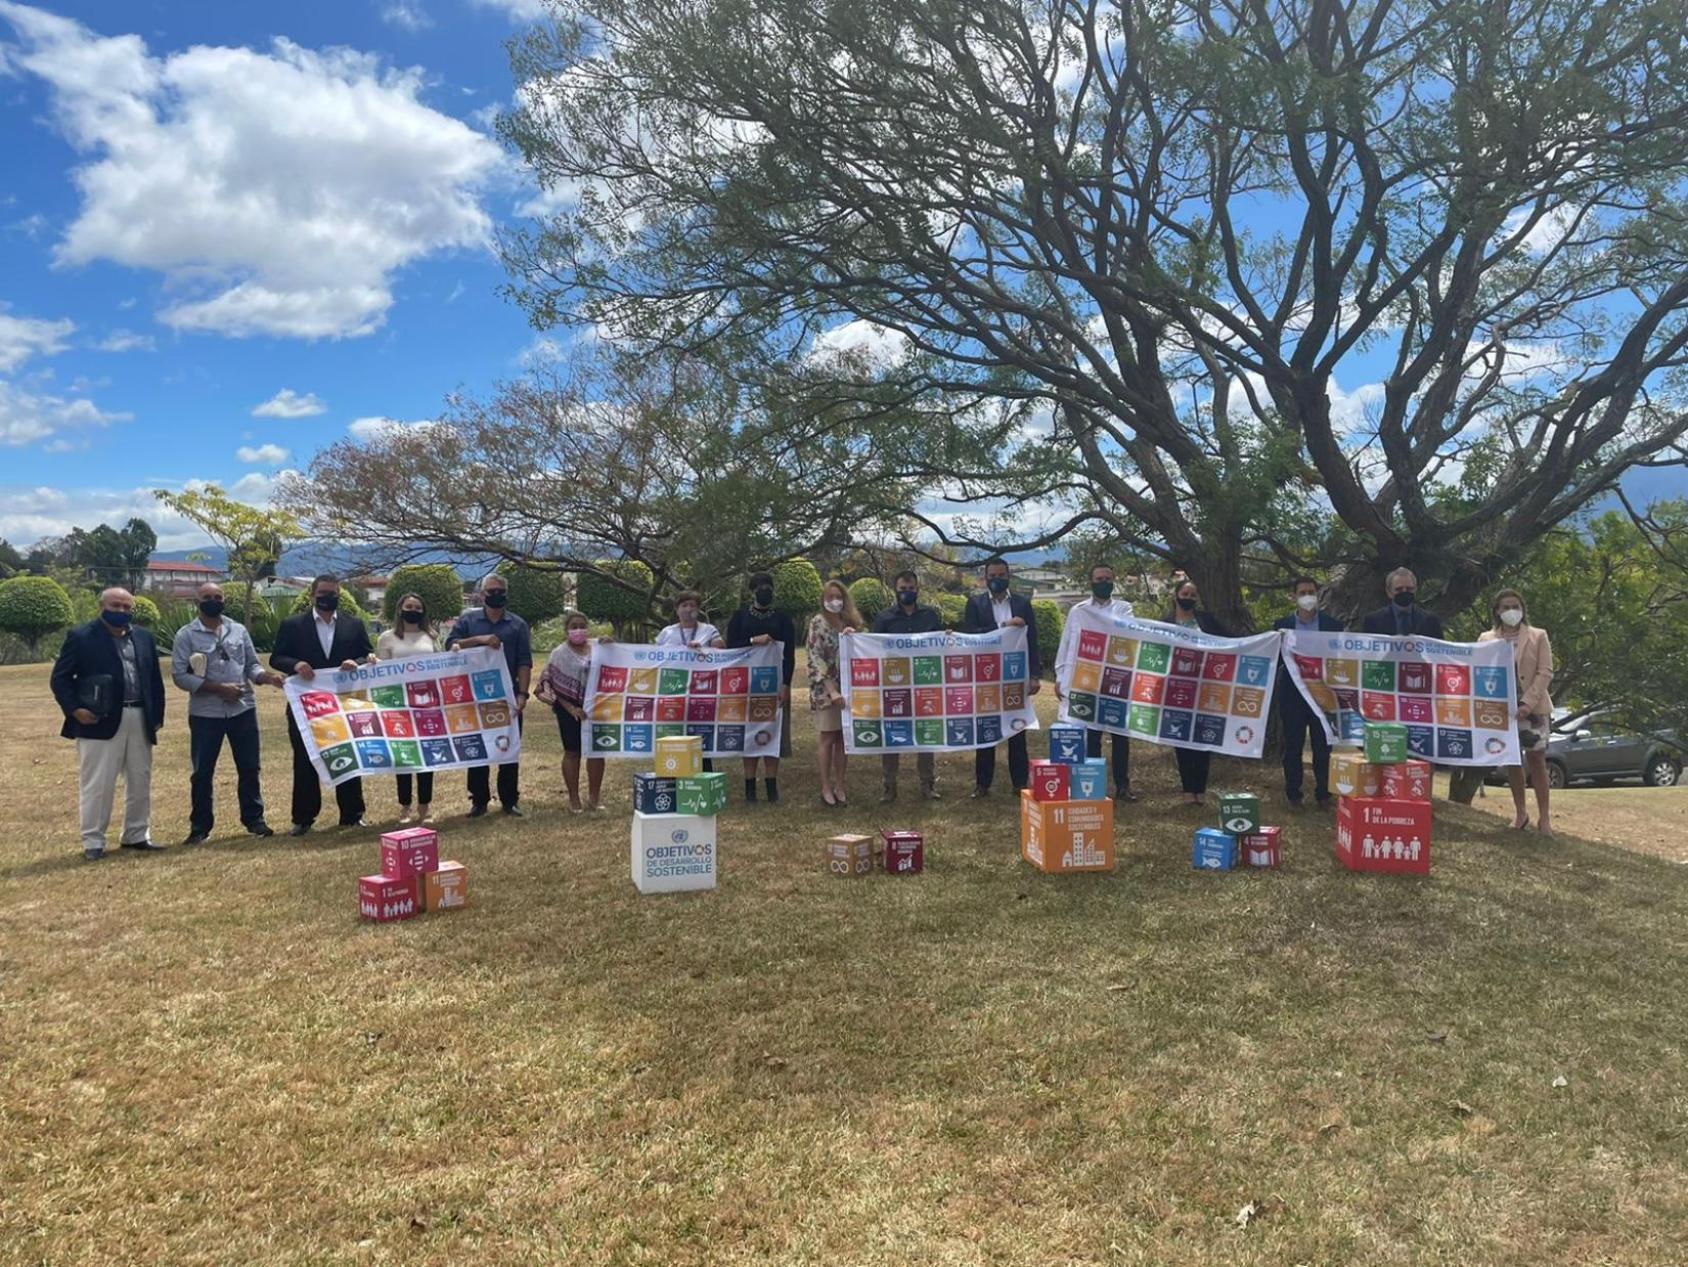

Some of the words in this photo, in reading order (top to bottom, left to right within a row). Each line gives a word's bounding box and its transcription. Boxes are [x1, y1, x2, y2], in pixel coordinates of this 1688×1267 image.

[896, 637, 962, 649] OBJETIVOS
[1344, 639, 1424, 653] OBJETIVOS
[648, 651, 714, 663] OBJETIVOS
[349, 660, 425, 681] OBJETIVOS
[1054, 808, 1064, 824] 11
[1363, 807, 1370, 823] 1
[1373, 807, 1382, 815] FIN
[1372, 816, 1380, 824] DE
[1380, 816, 1388, 824] LA
[401, 840, 409, 849] 10
[646, 844, 712, 859] OBJETIVOS
[647, 860, 656, 868] DE
[659, 857, 712, 867] DESARROLLO
[647, 864, 712, 878] SOSTENIBLE
[382, 888, 386, 897] 1
